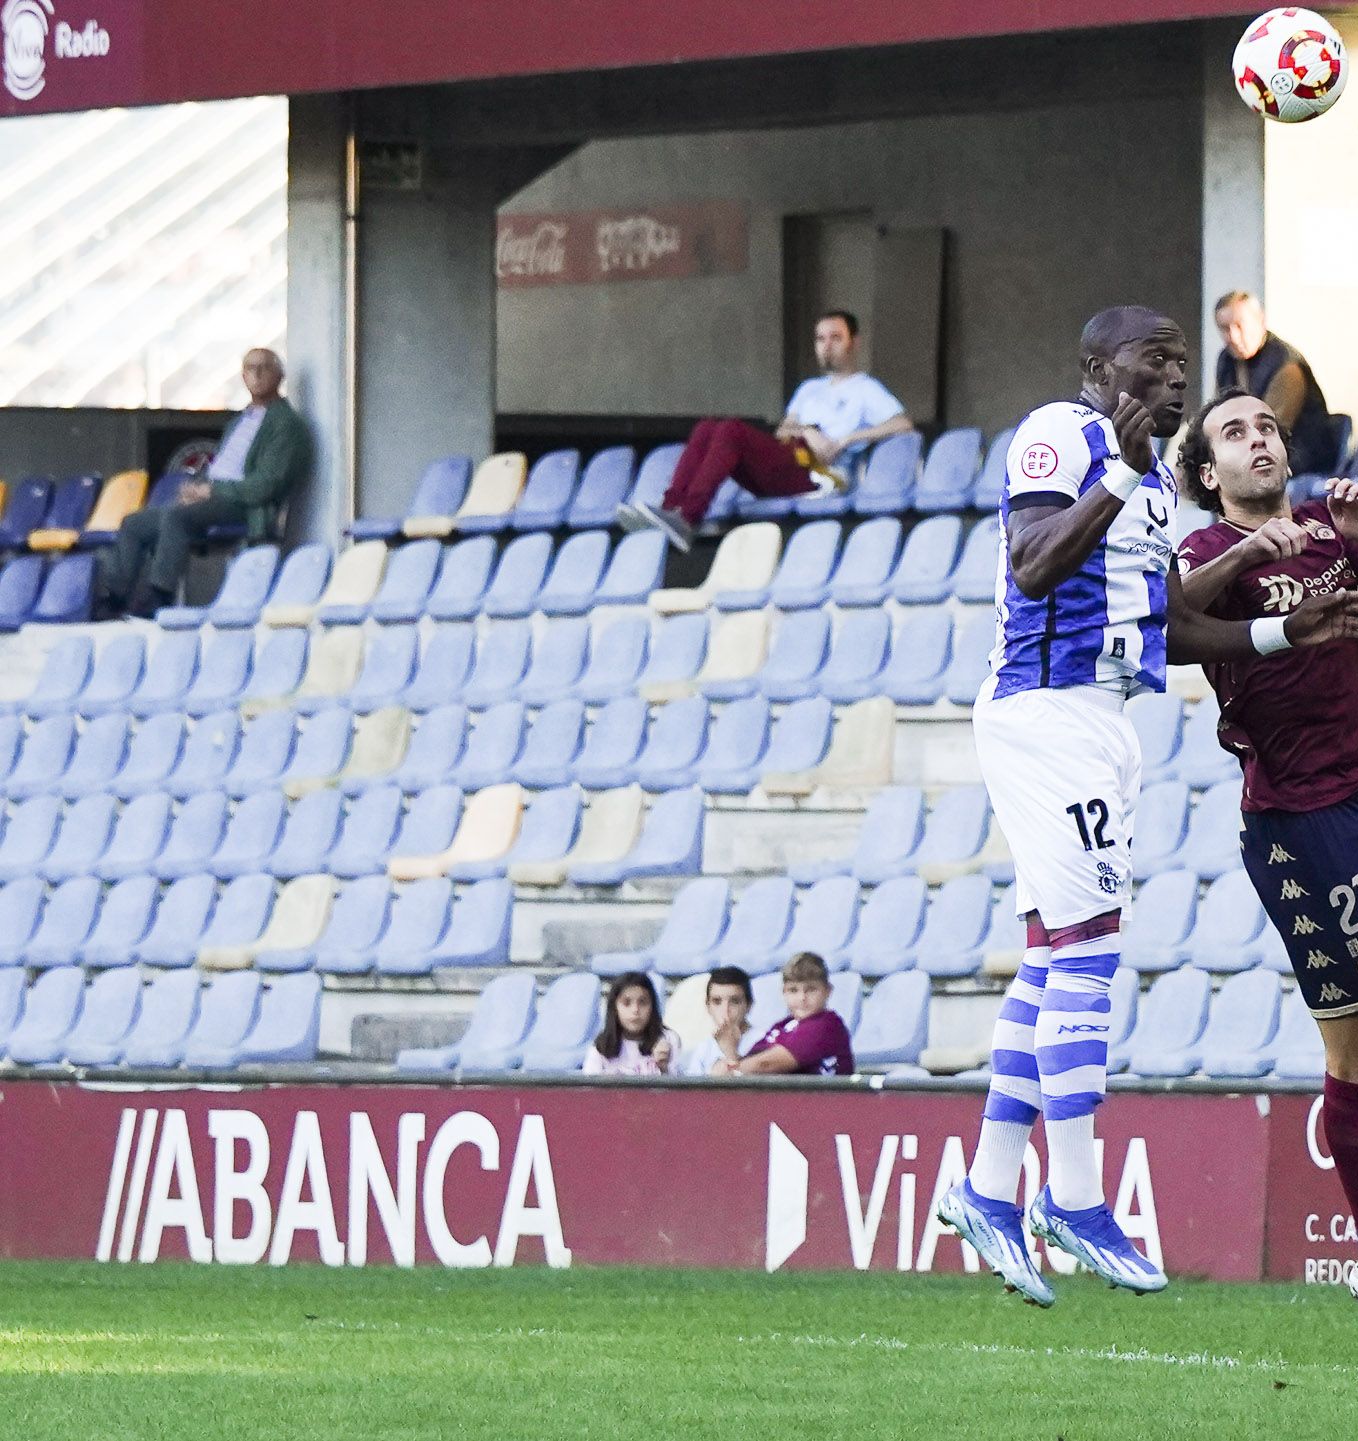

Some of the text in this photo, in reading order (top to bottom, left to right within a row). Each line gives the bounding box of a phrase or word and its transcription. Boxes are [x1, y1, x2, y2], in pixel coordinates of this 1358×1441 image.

[55, 20, 110, 58] Radio
[1066, 798, 1116, 851] 12
[137, 1108, 573, 1268] ABANCA
[1305, 1213, 1326, 1242] C.
